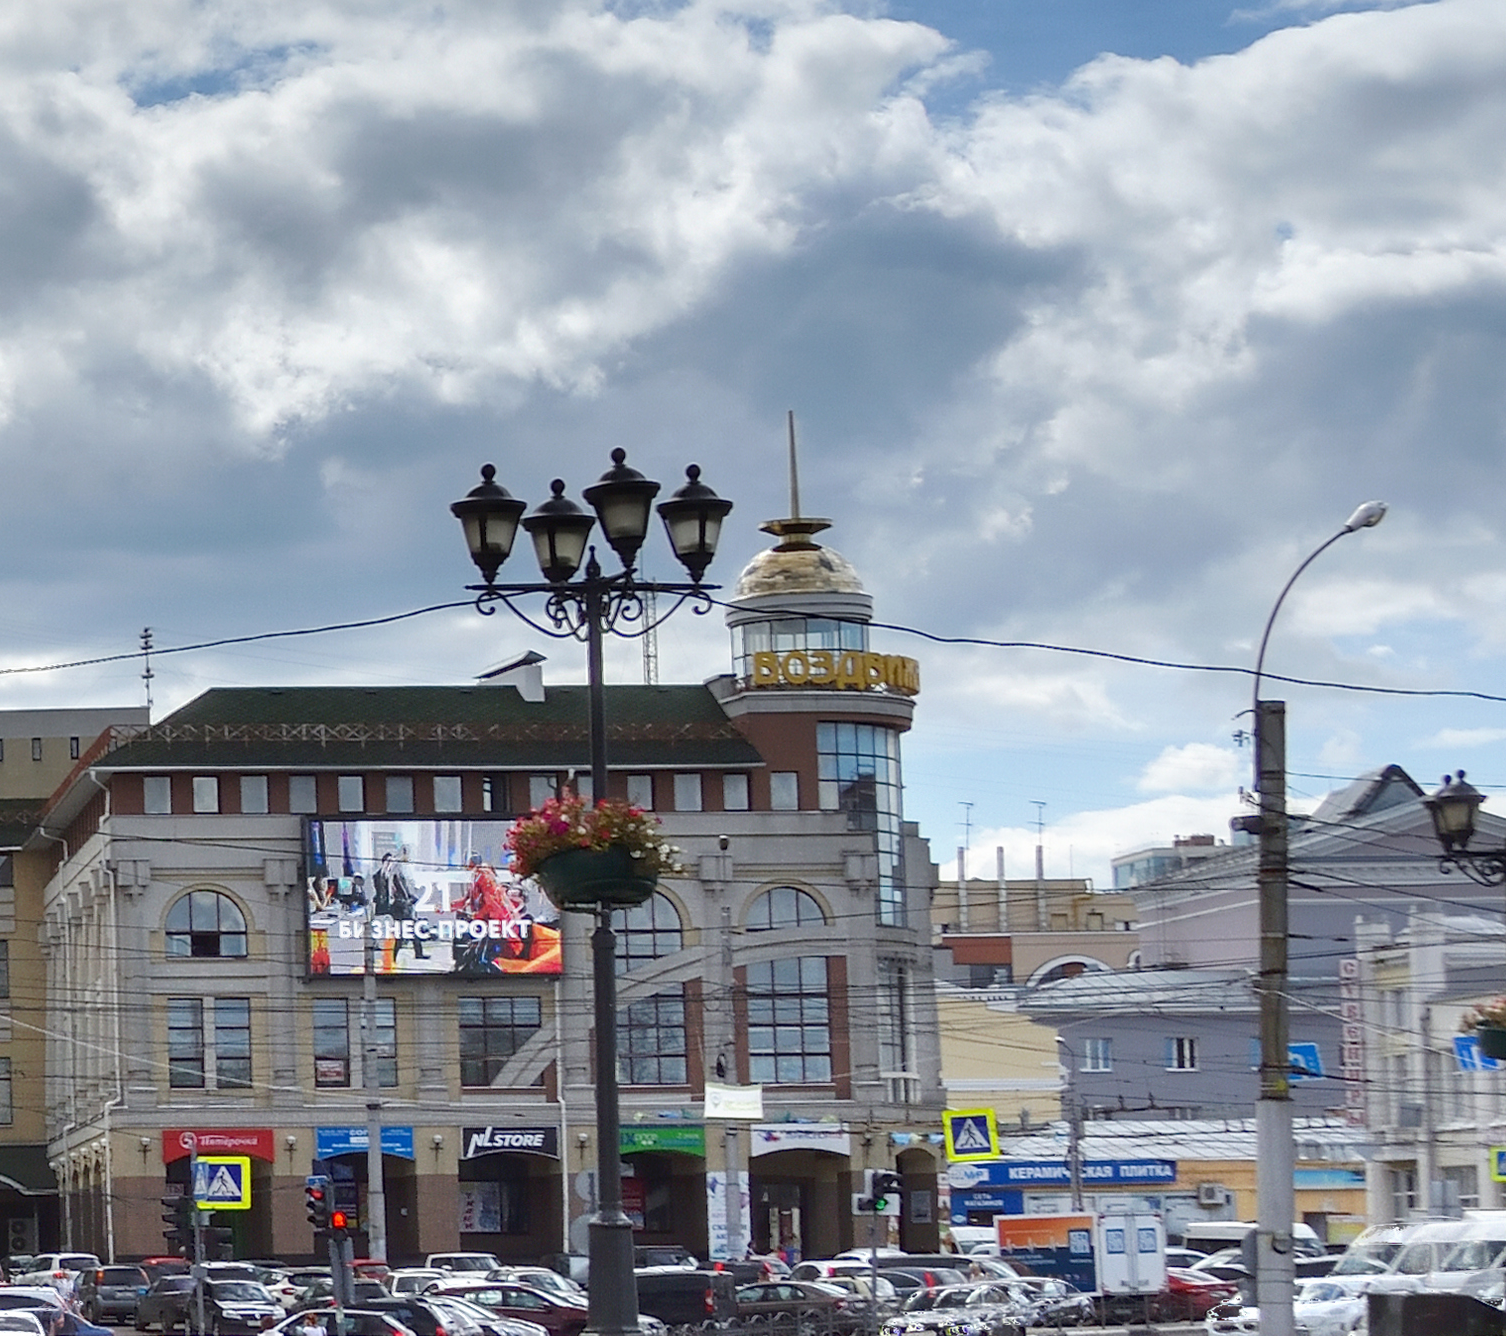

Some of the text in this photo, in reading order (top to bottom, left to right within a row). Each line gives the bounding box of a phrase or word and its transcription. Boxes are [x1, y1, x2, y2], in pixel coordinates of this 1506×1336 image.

[339, 919, 531, 941] БИЗНЕС-ПРОЕКТ
[1009, 1164, 1173, 1180] КЕРАМИЧСКАЯ ПЛИТКА
